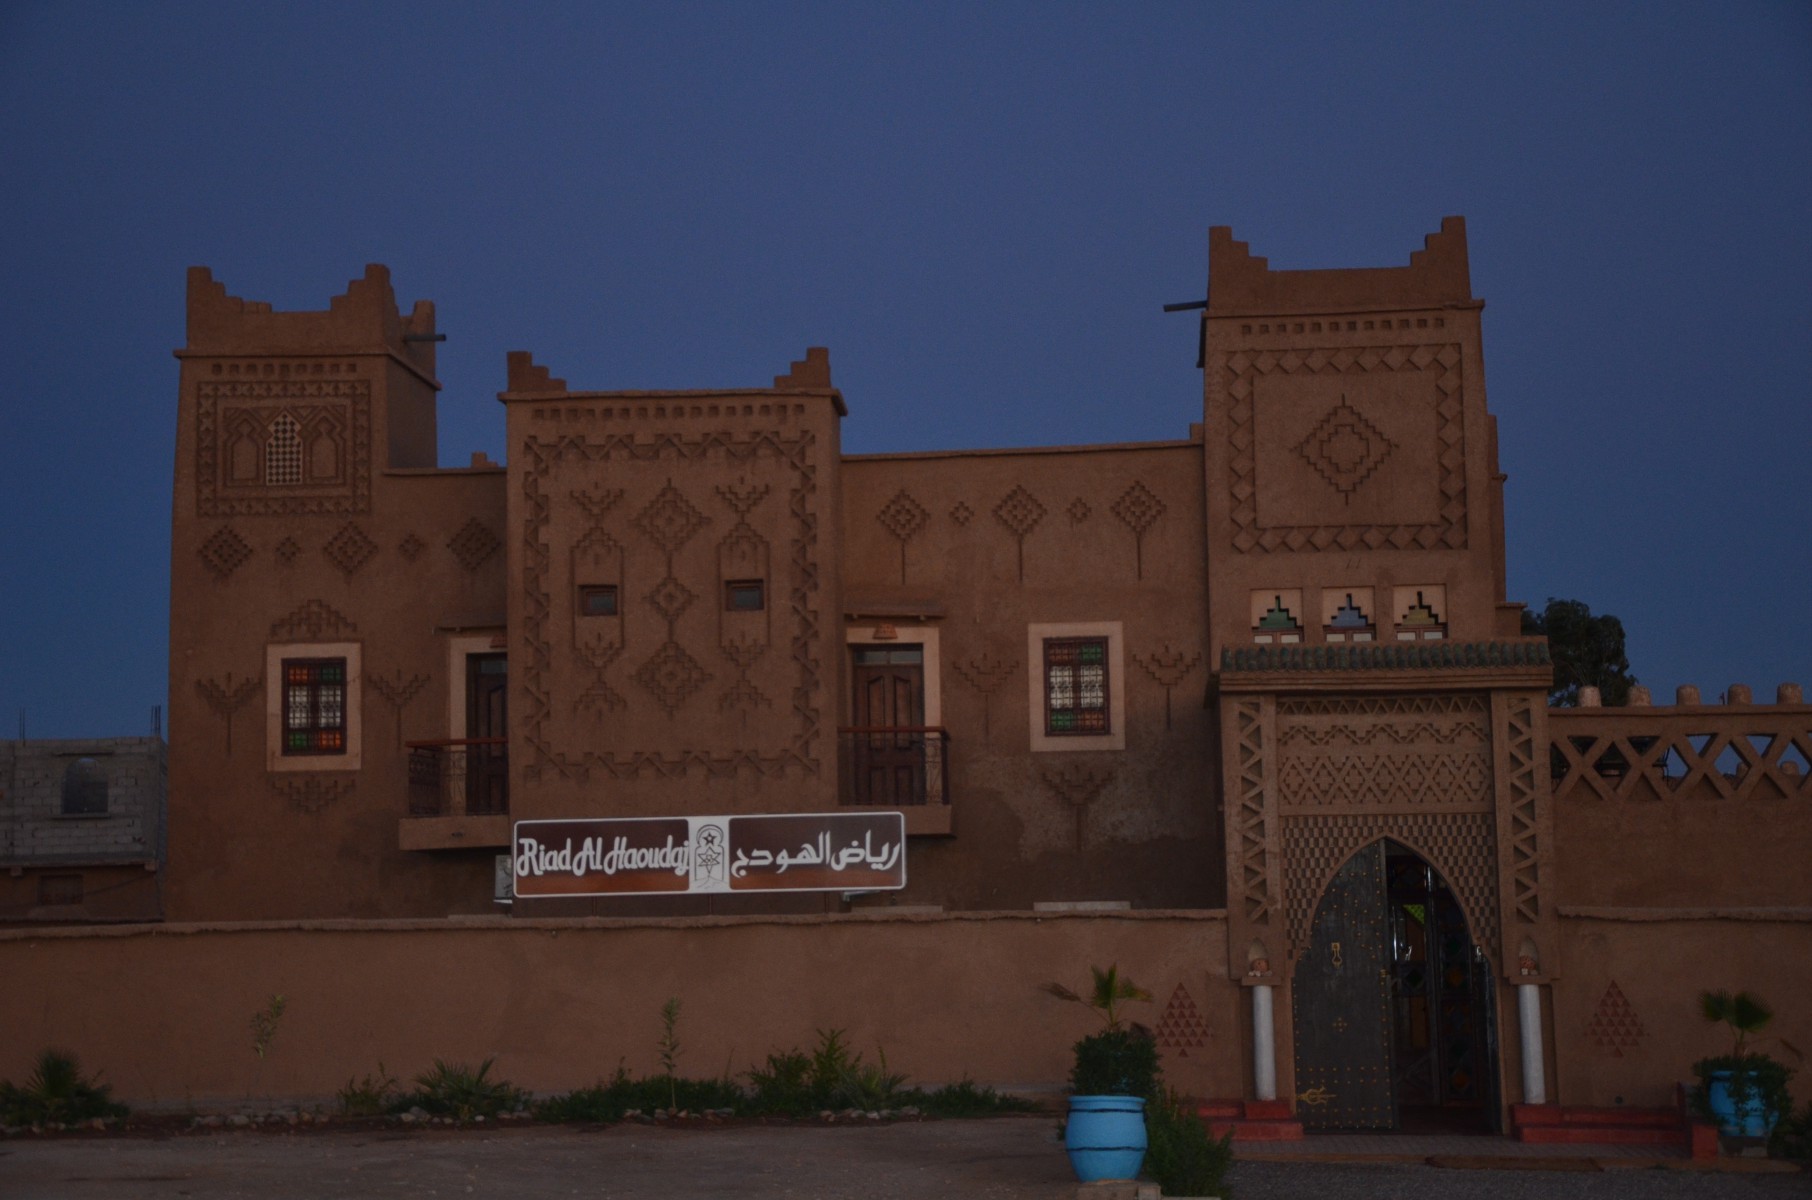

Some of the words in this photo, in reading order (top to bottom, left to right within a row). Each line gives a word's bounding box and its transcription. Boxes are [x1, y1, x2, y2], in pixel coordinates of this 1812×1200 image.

[516, 837, 571, 877] Riad
[572, 836, 603, 876] Al
[602, 835, 690, 876] Haoudaj
[731, 830, 830, 878] الهودج
[830, 829, 901, 871] رياض
